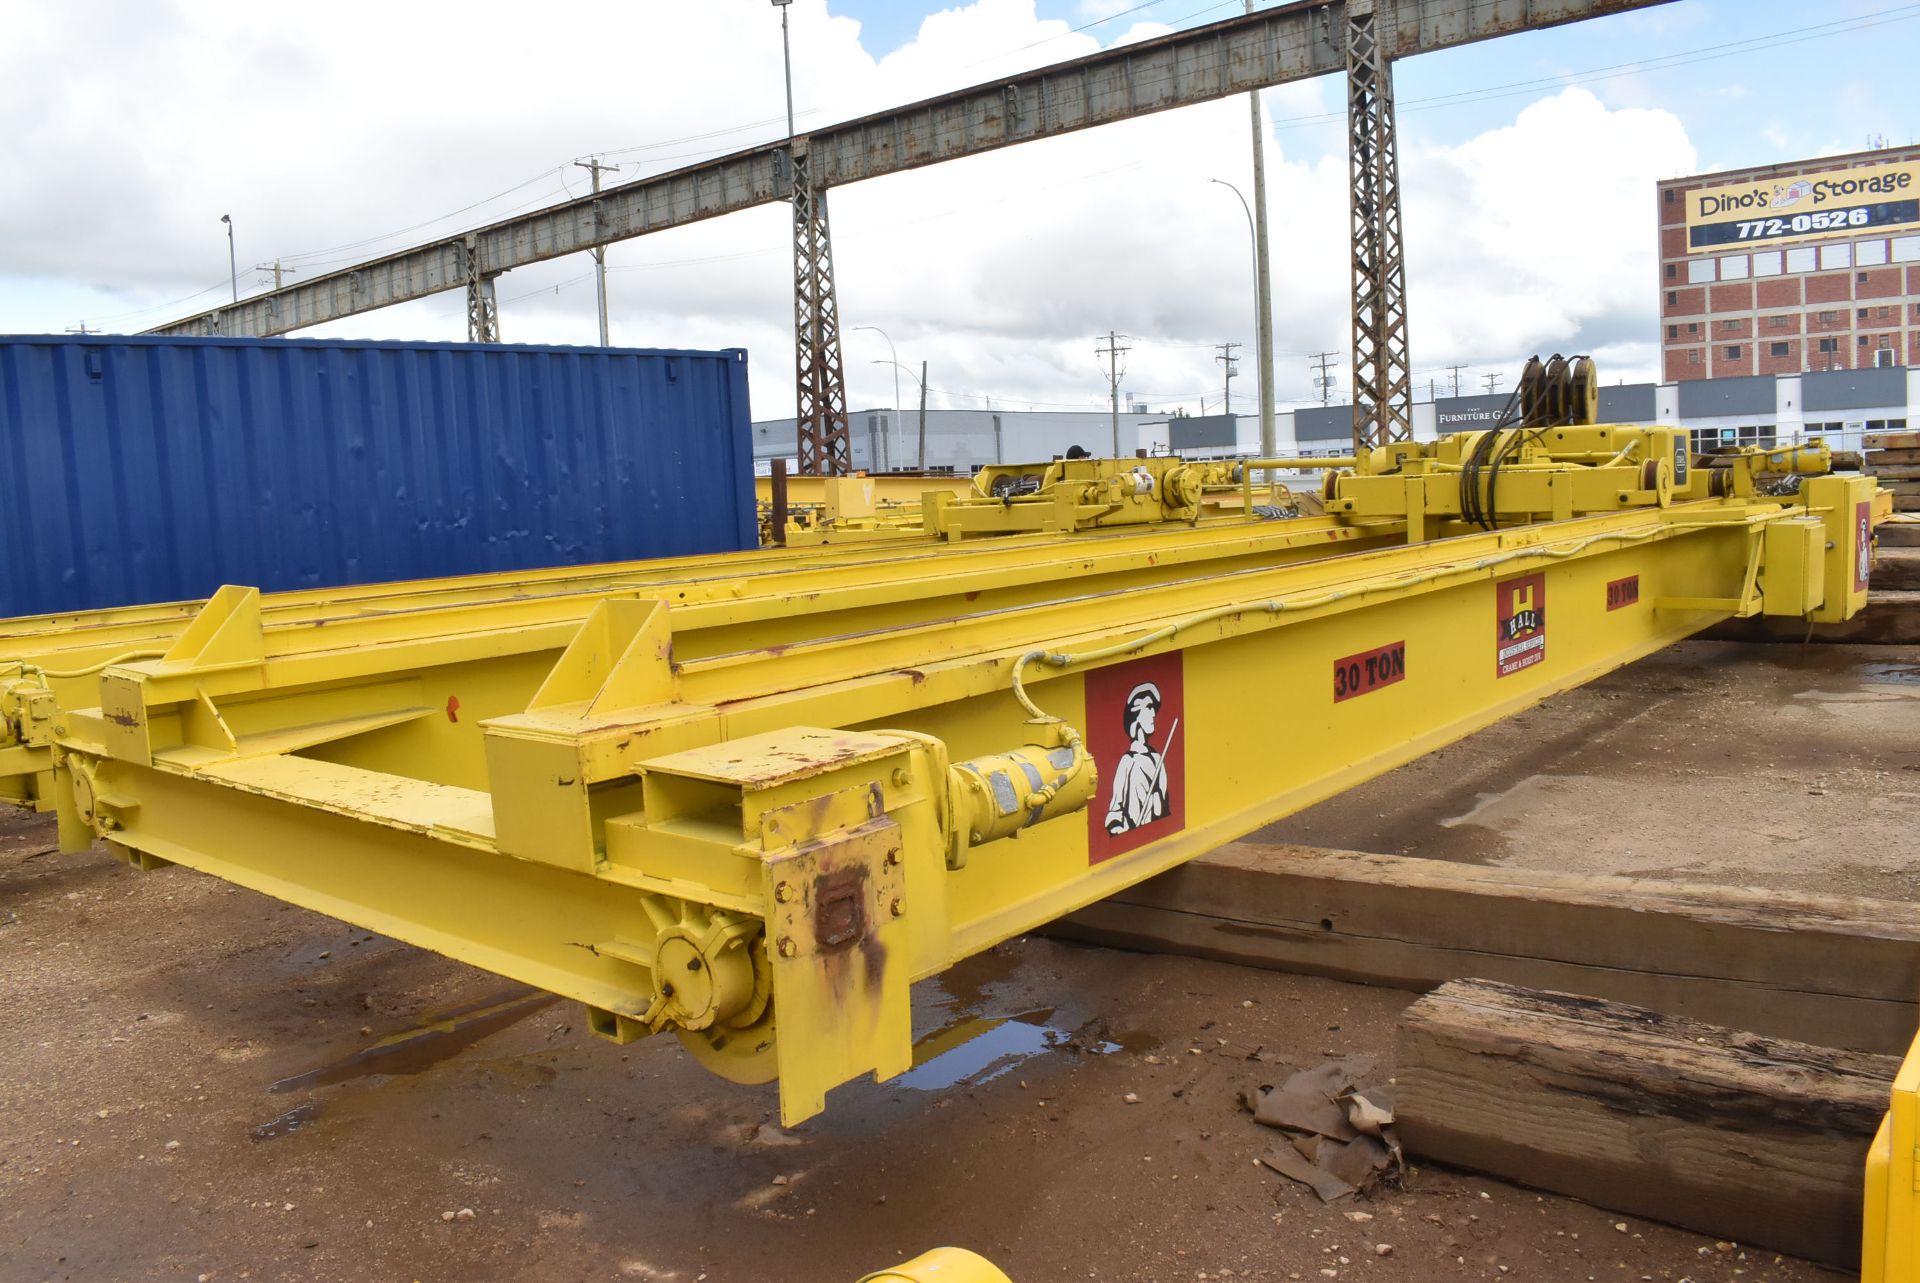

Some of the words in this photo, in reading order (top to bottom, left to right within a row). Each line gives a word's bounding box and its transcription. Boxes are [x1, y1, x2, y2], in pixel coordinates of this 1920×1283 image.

[1700, 189, 1769, 217] Dino's
[1812, 172, 1911, 204] Storage
[1736, 208, 1869, 239] 772-0526
[1439, 413, 1490, 423] FURNITURE
[1608, 585, 1619, 606] 30
[1620, 578, 1639, 603] TON
[1510, 611, 1536, 636] HALL
[1336, 663, 1360, 697] 30
[1365, 647, 1405, 687] TON
